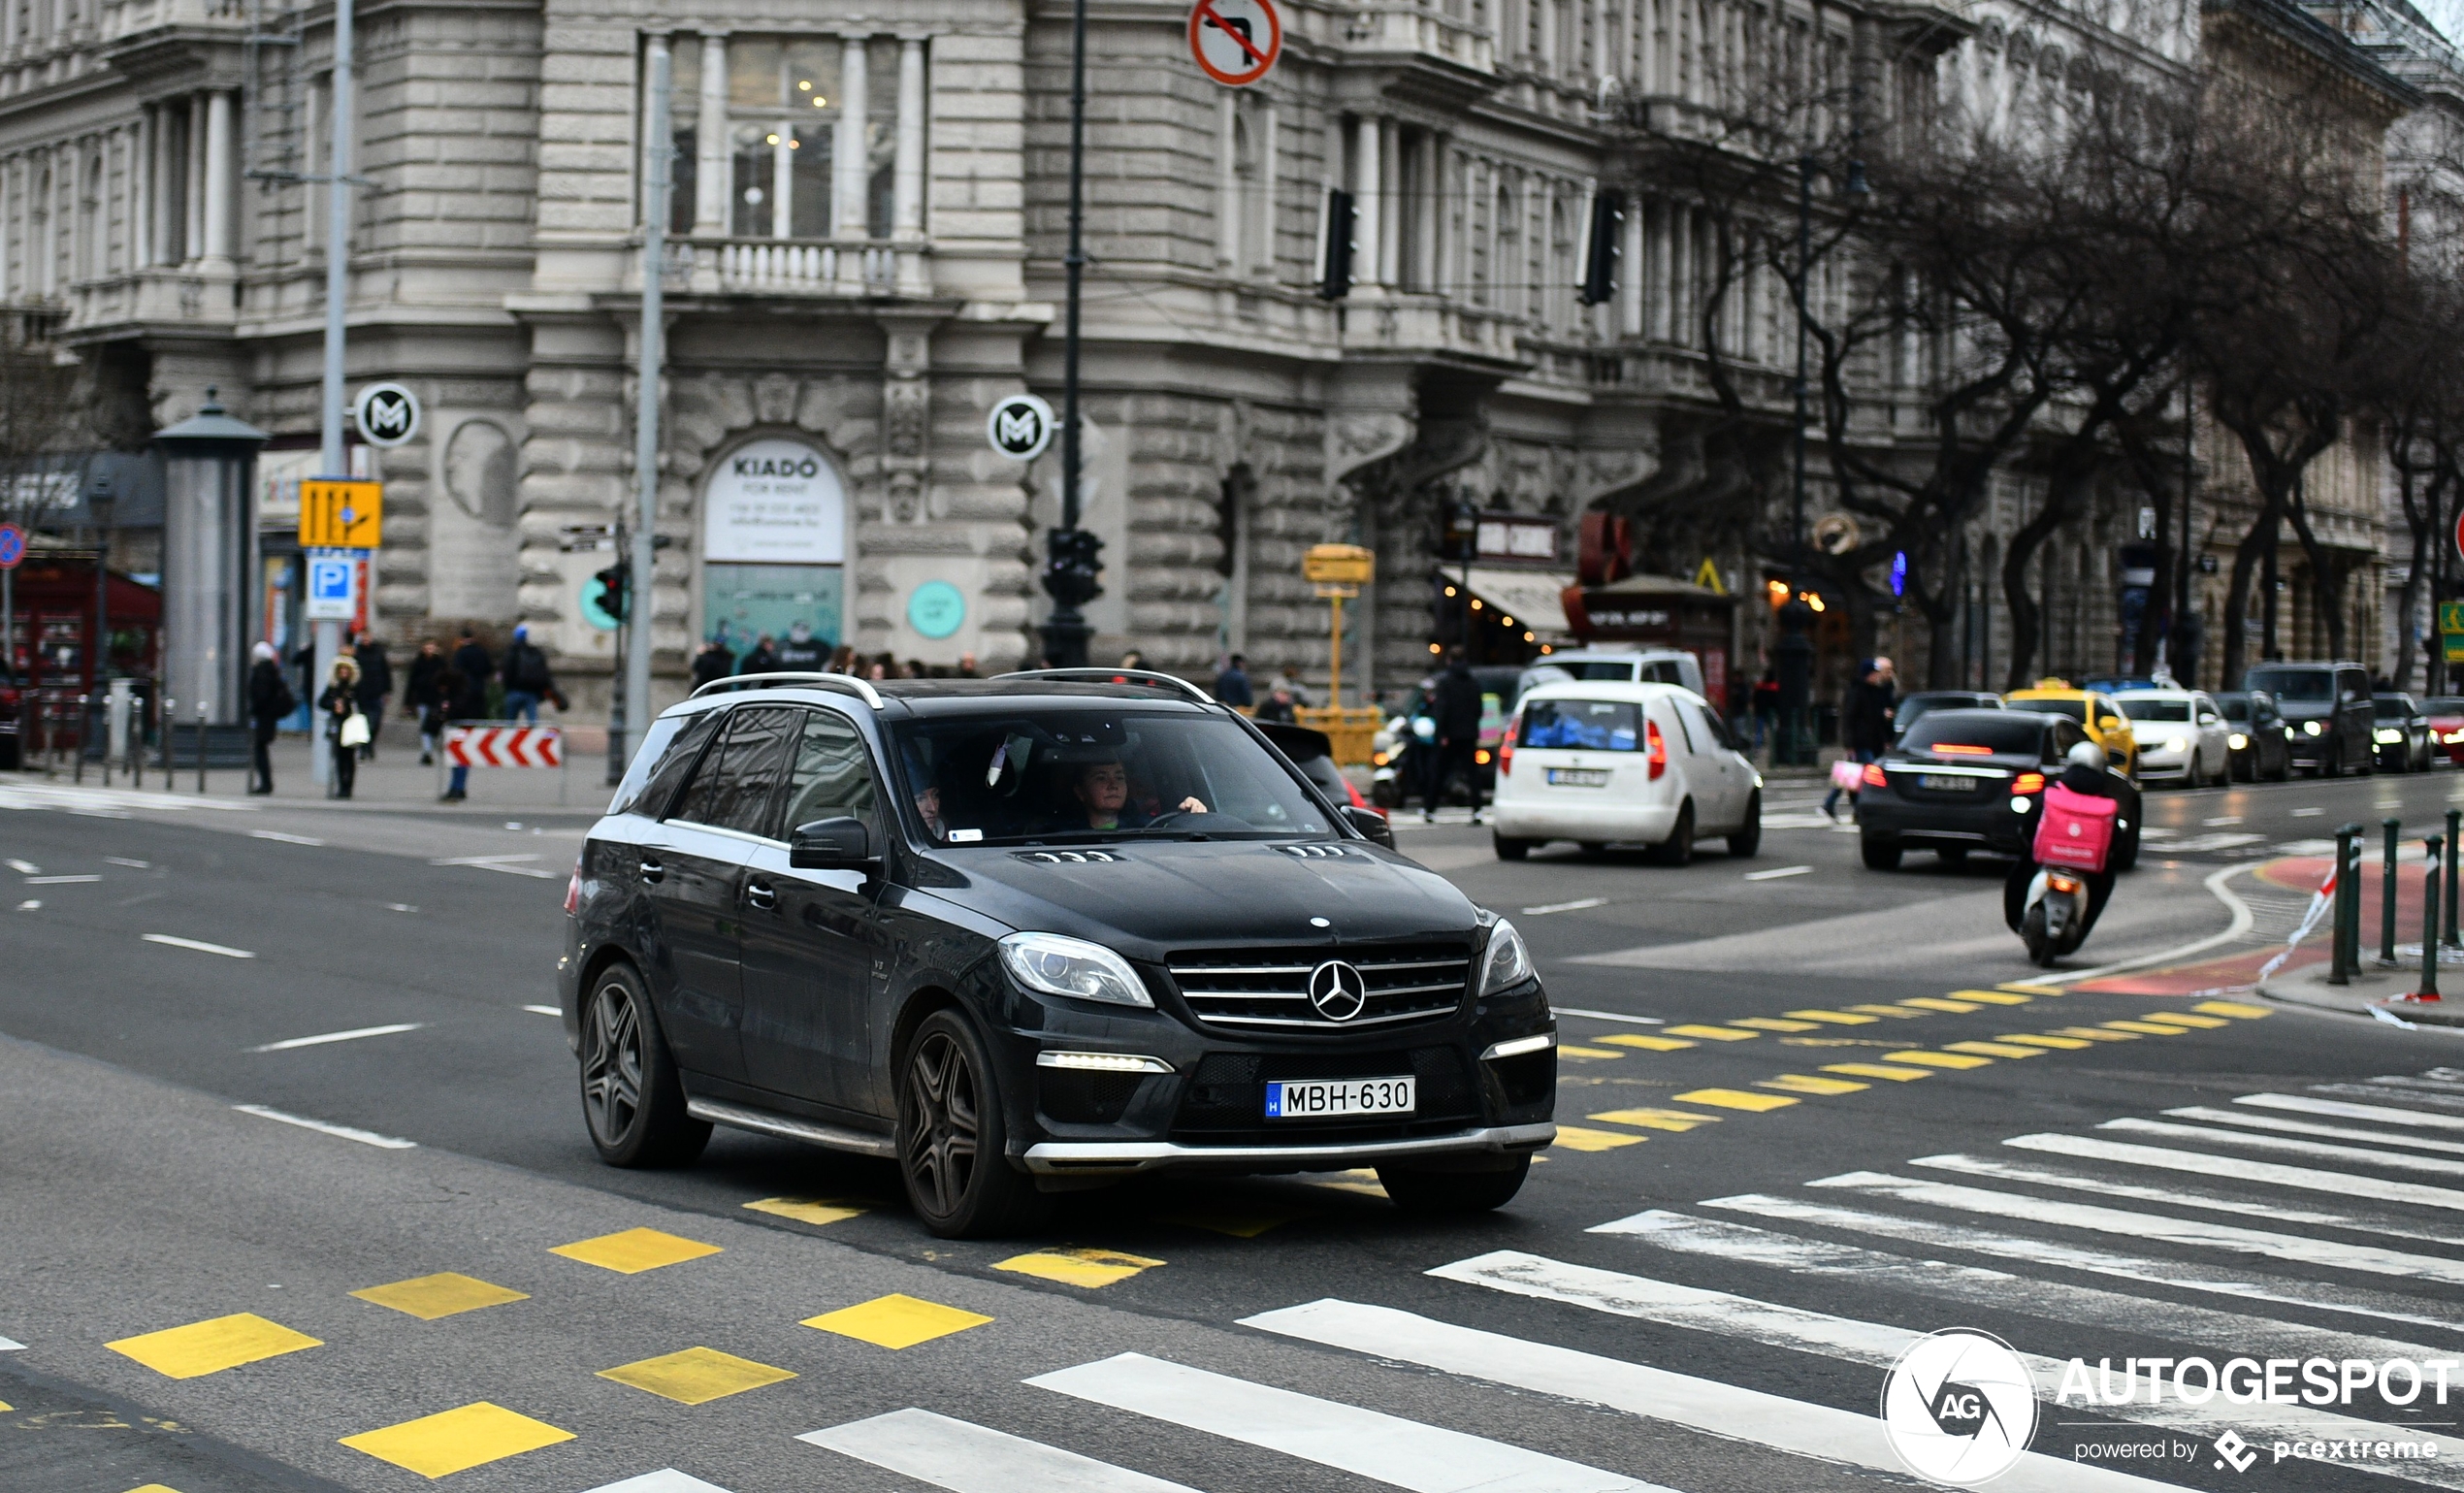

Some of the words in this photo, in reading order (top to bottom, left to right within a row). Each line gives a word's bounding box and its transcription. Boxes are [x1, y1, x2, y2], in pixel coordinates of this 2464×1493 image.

[733, 453, 818, 478] KIADÓ
[318, 567, 344, 595] P
[1269, 1102, 1277, 1113] H
[1287, 1082, 1409, 1112] MBH-630
